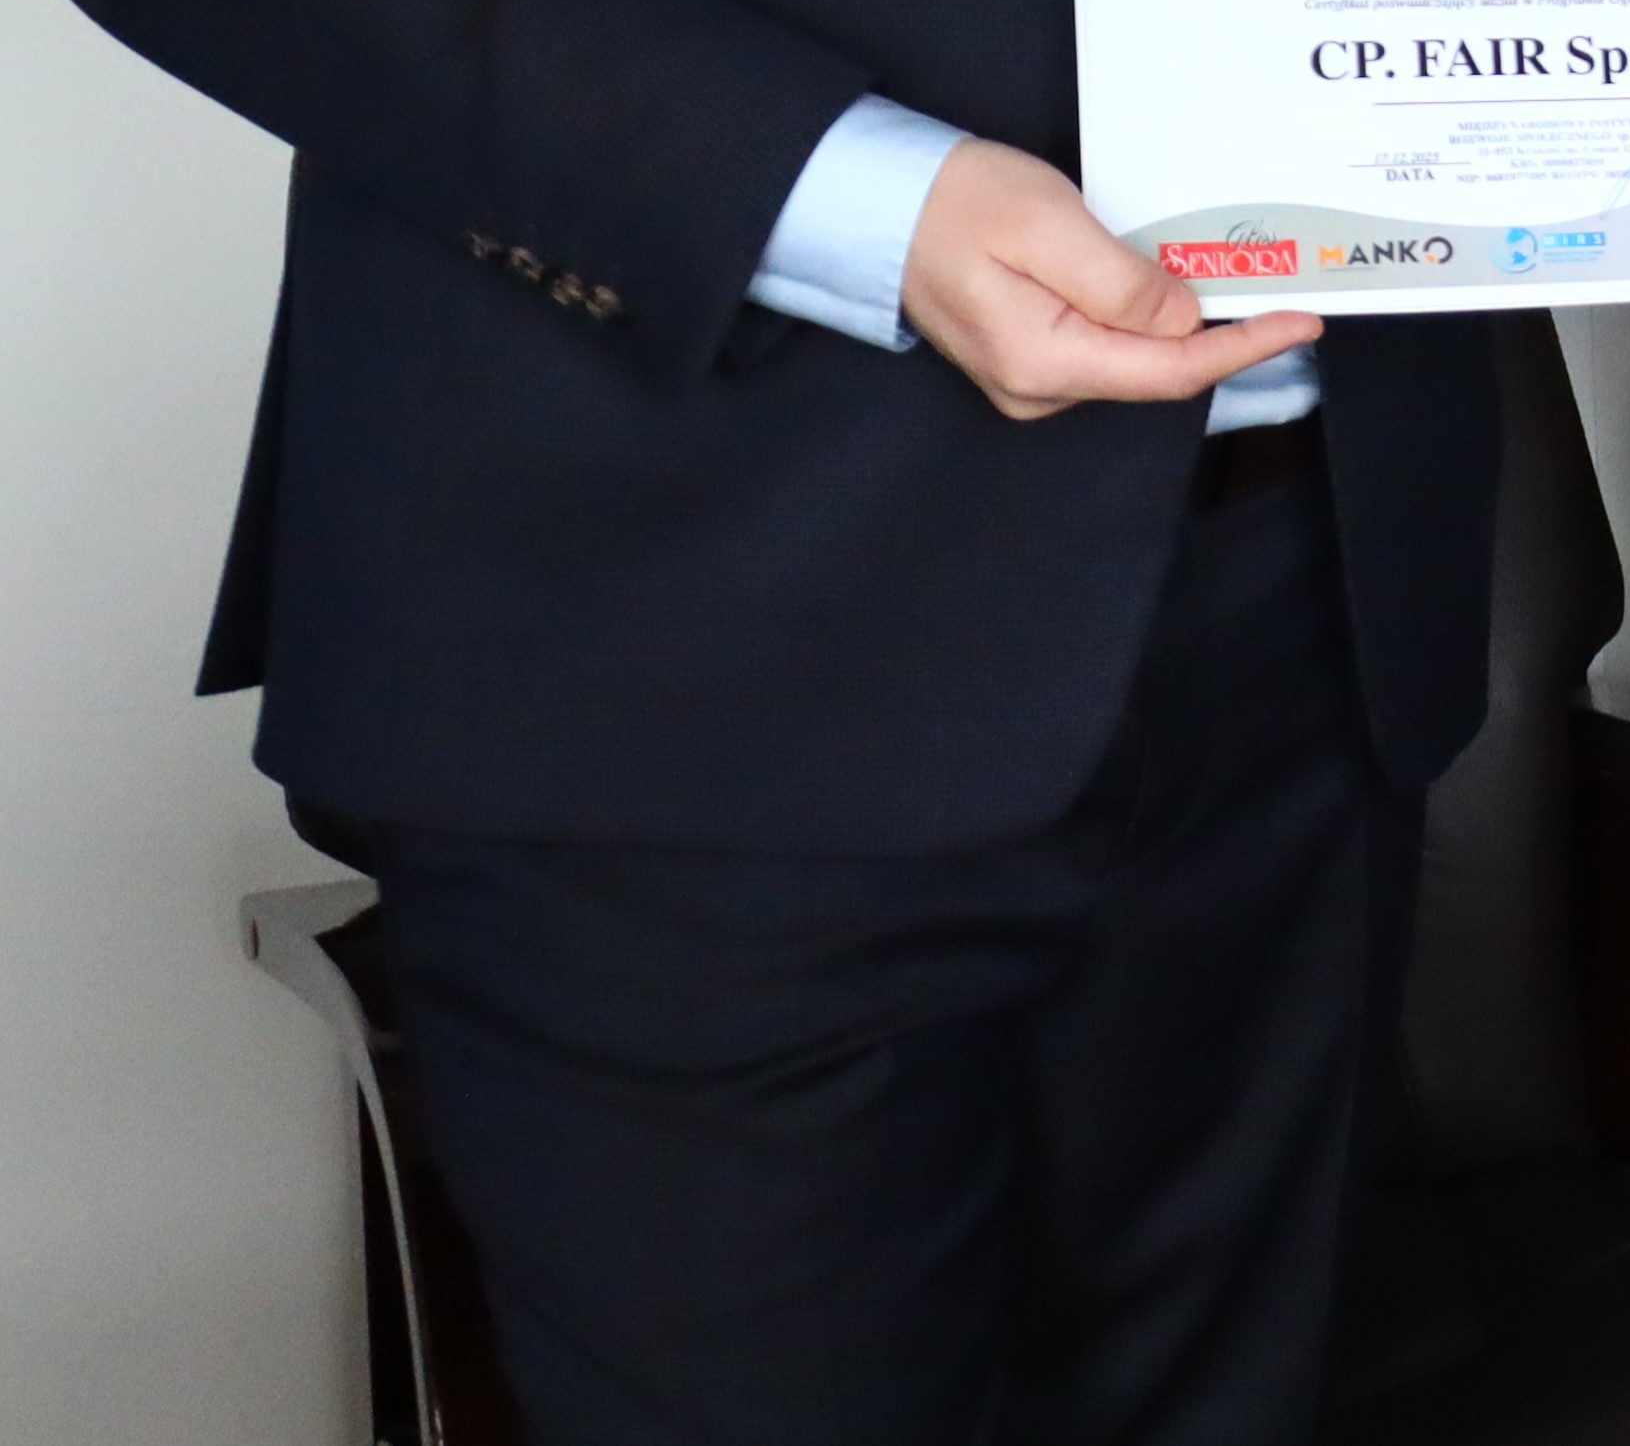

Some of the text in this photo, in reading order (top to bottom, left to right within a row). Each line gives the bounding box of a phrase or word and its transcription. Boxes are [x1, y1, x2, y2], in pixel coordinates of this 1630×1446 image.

[1310, 38, 1395, 81] CP.
[1413, 36, 1551, 79] FAIR
[1385, 168, 1436, 182] DATA
[1162, 244, 1296, 277] SENIORA
[1317, 236, 1454, 267] MANKO
